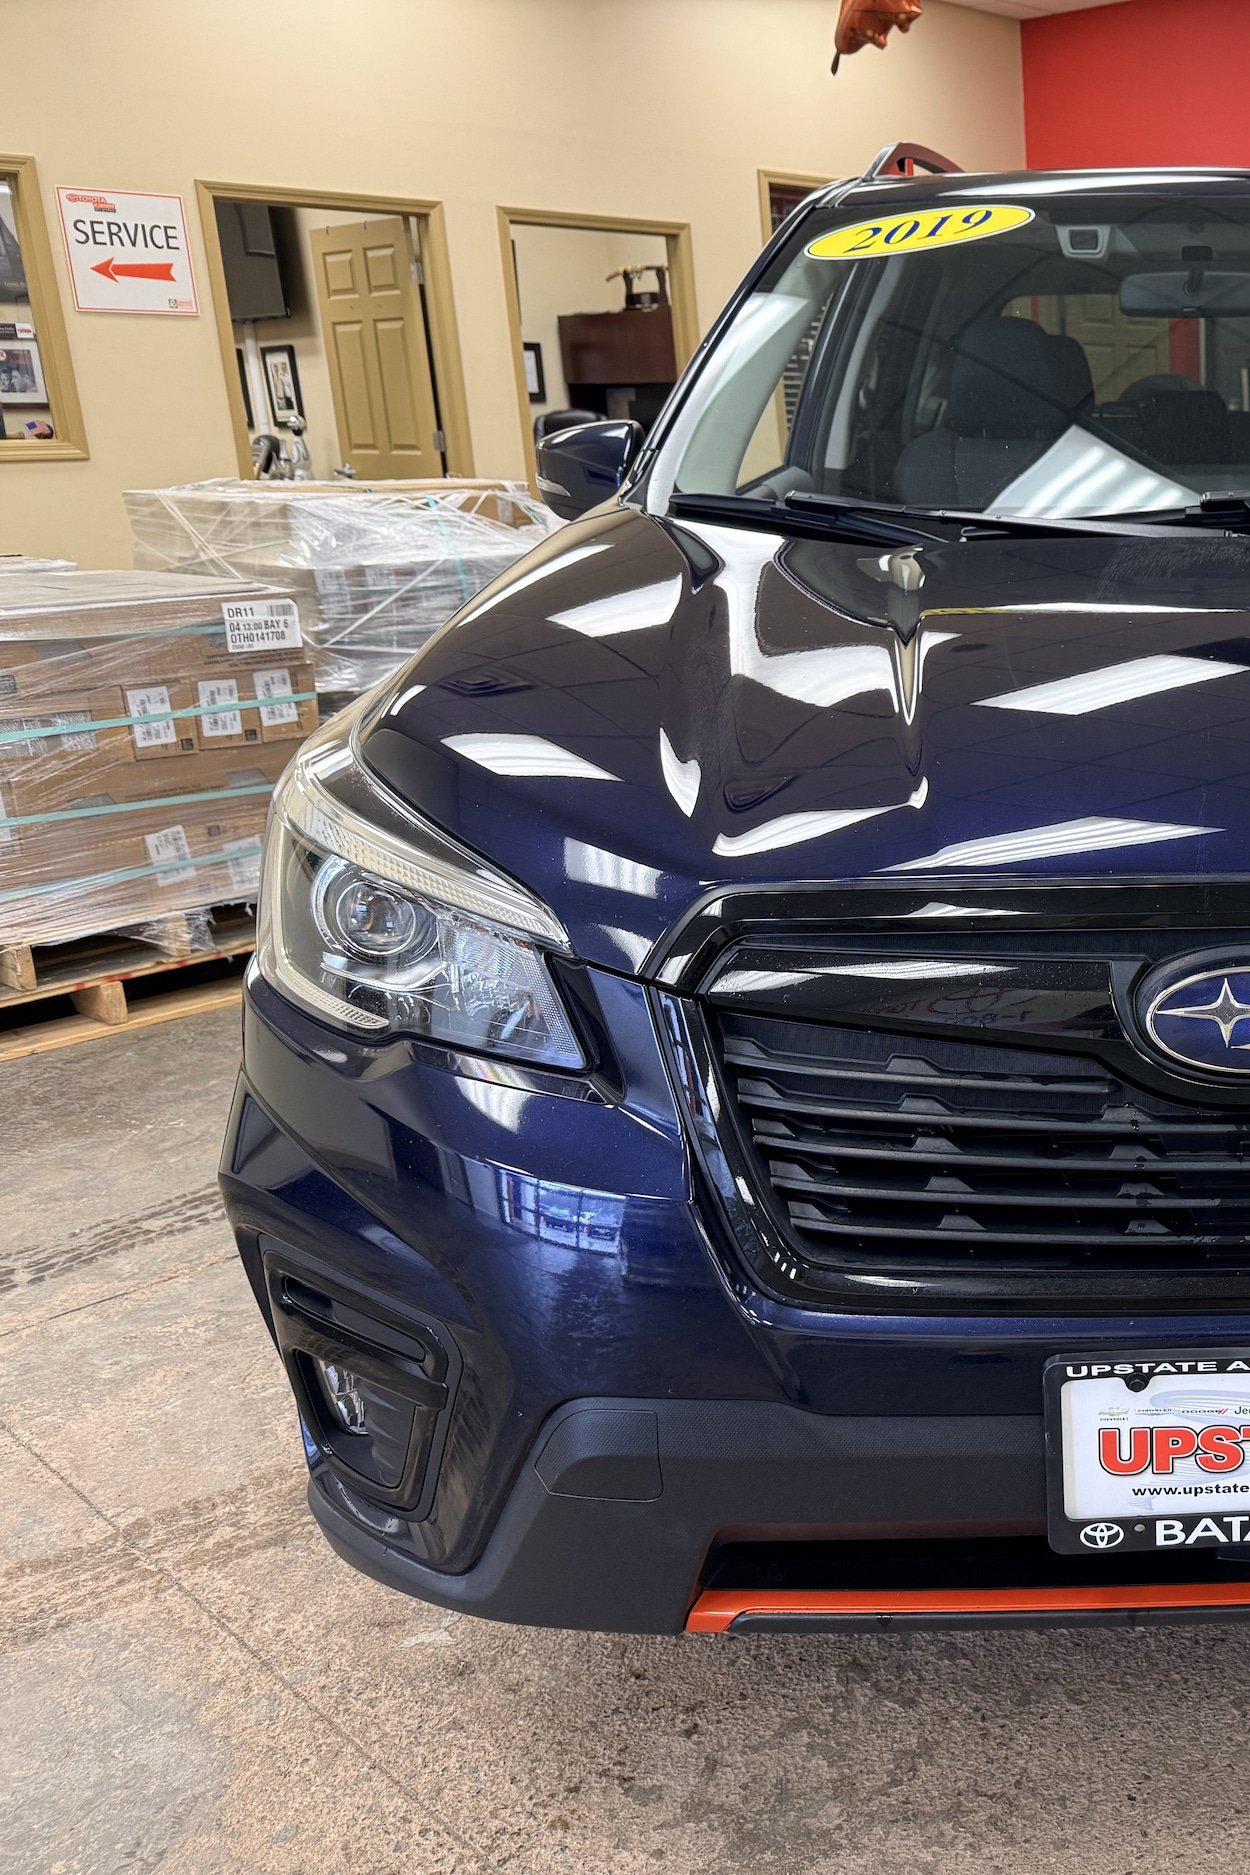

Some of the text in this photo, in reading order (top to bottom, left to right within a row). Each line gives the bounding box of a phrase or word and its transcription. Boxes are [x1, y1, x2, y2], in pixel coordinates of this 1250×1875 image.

[73, 219, 180, 250] SERVICE
[843, 210, 993, 254] 2019
[227, 607, 254, 618] DR11
[229, 619, 289, 632] 04 13:00 BAY 6
[1066, 1361, 1218, 1378] UPSTATE
